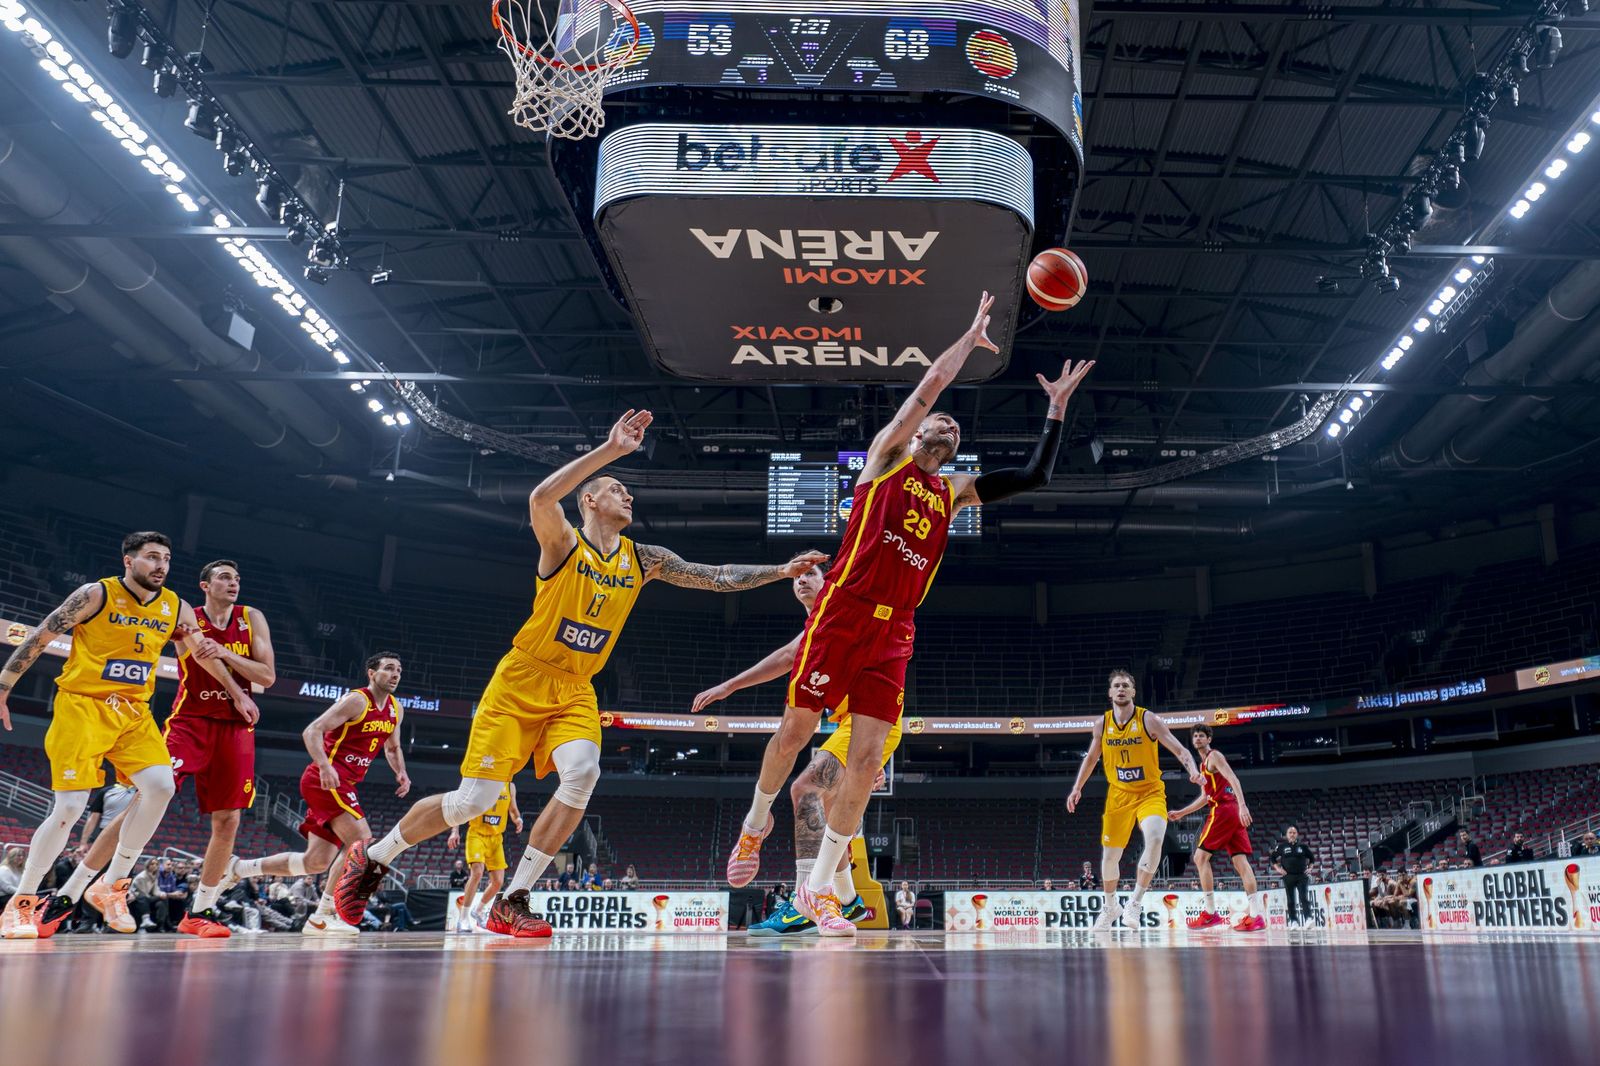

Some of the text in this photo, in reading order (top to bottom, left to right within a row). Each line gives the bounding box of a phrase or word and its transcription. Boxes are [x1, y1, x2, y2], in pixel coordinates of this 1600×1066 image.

[789, 18, 831, 35] 7:27
[688, 24, 732, 56] 53
[884, 29, 930, 60] 68
[676, 132, 883, 174] betsafe
[689, 228, 940, 266] ARĒNA
[783, 267, 927, 285] XIAOMI
[730, 325, 862, 341] XIAOMI
[731, 341, 932, 366] ARĒNA
[848, 457, 864, 470] 53
[903, 477, 946, 517] ESPAÑA
[903, 509, 932, 540] 29
[577, 560, 634, 588] UKRAINE
[585, 593, 607, 617] 13
[108, 612, 170, 633] UKRAINE
[134, 632, 145, 653] 5
[562, 624, 605, 649] BGV
[299, 682, 342, 702] Atklāj
[1395, 686, 1438, 707] jaunas
[1440, 678, 1486, 701] garšas!
[368, 737, 379, 752] 6
[1106, 736, 1142, 746] UKRAINE
[1117, 769, 1140, 780] BGV
[869, 836, 889, 847] 108
[1483, 869, 1551, 900] GLOBAL
[546, 896, 633, 912] GLOBAL
[1438, 899, 1468, 909] WORLD CUP
[1473, 896, 1569, 927] PARTNERS
[673, 918, 720, 927] QUALIFIERS
[993, 917, 1039, 926] QUALIFIERS
[1439, 910, 1470, 924] QUALIFIERS
